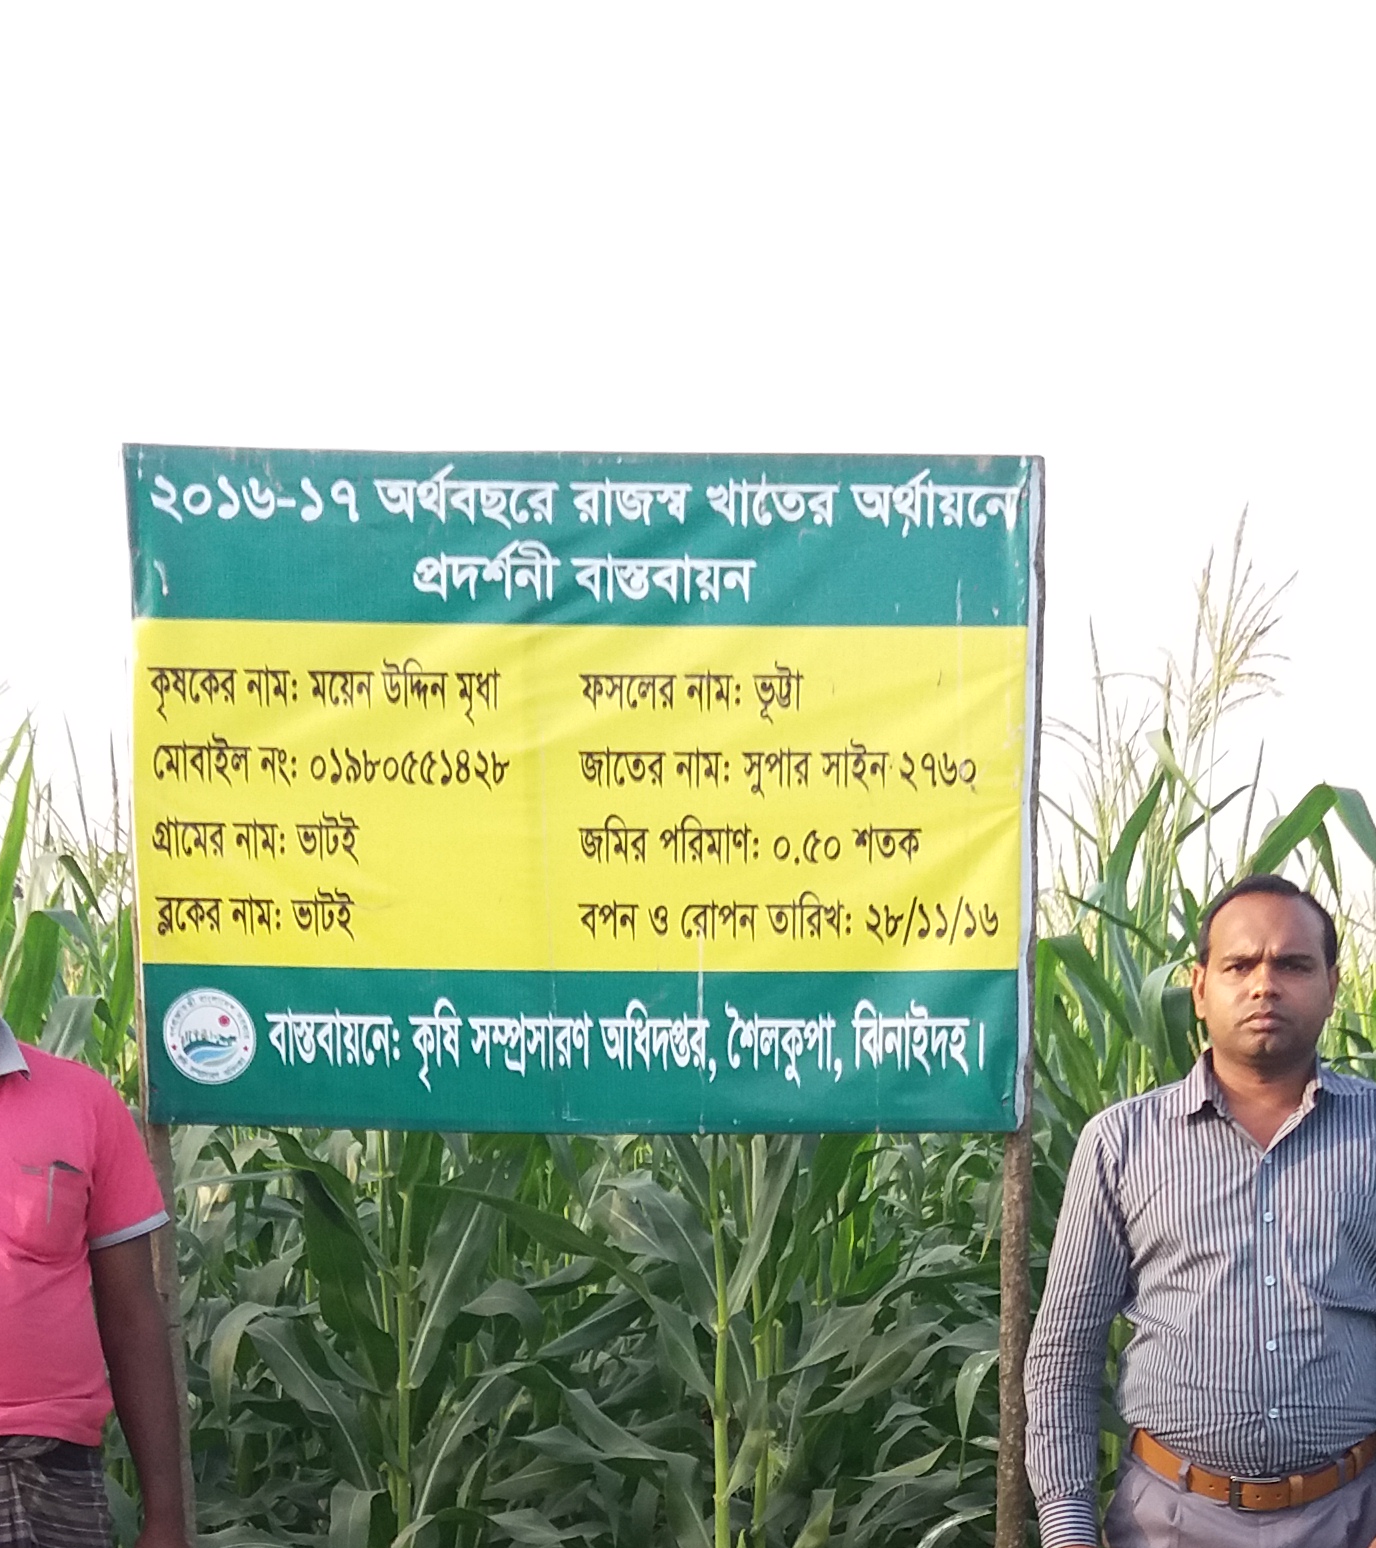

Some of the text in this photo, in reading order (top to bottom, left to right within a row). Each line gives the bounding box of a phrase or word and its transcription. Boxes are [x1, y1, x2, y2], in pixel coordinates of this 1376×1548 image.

[150, 474, 360, 523] ২০১৬-১৭
[373, 463, 559, 530] অর্থবছরে
[569, 477, 693, 527] রাজস্ব
[706, 473, 840, 528] খাতের
[413, 539, 757, 603] প্রদর্শনী বাস্তবায়ন
[147, 667, 237, 722] কৃষকের
[243, 665, 298, 707] নাম:
[307, 670, 375, 708] ময়েন
[381, 658, 449, 709] উদ্দিন
[579, 674, 677, 710] ফসলের
[684, 670, 741, 711] নাম:
[153, 732, 510, 790] মোবাইল নং: ০১৯৮০৫৫১৪২৮
[578, 738, 977, 798] জাতের নাম: সুপার সাইন ২৭৬০
[152, 811, 360, 865] গ্রামের নাম: ভাটই
[578, 814, 922, 865] জমির পরিমাণ: ০.৫০ শতক
[155, 887, 355, 940] ব্লকের নাম: ভাটই
[578, 890, 999, 946] বপন ও রোপন তারিখ: ২৮/১১/১৬
[265, 1008, 400, 1066] বাস্তবায়নে:
[408, 997, 463, 1091] কৃষি
[467, 1012, 594, 1076] সম্প্রসারণ
[598, 995, 717, 1083] অধিদপ্তর,
[724, 1001, 843, 1088] শৈলকুপা,
